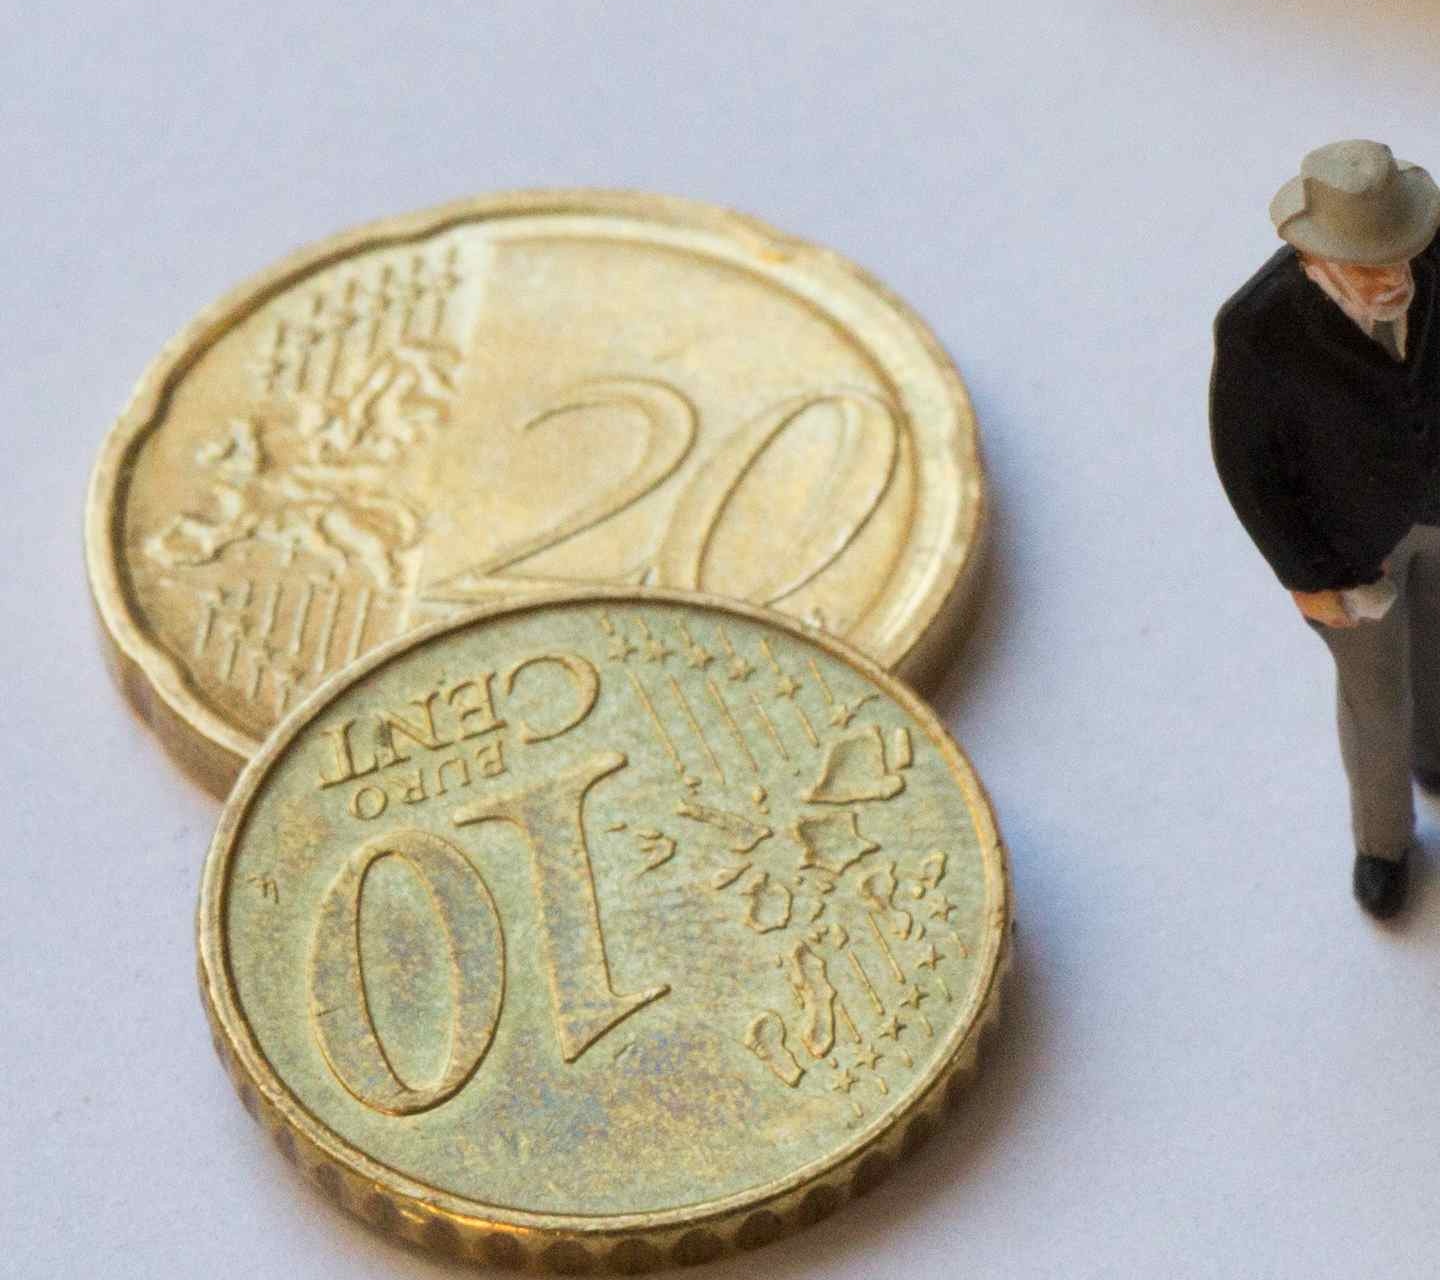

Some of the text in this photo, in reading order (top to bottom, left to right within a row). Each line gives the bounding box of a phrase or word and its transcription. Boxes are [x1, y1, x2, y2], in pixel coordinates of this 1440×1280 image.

[418, 375, 923, 640] 20
[319, 654, 601, 792] CENT
[350, 740, 508, 822] EURO
[308, 752, 671, 1116] 10
